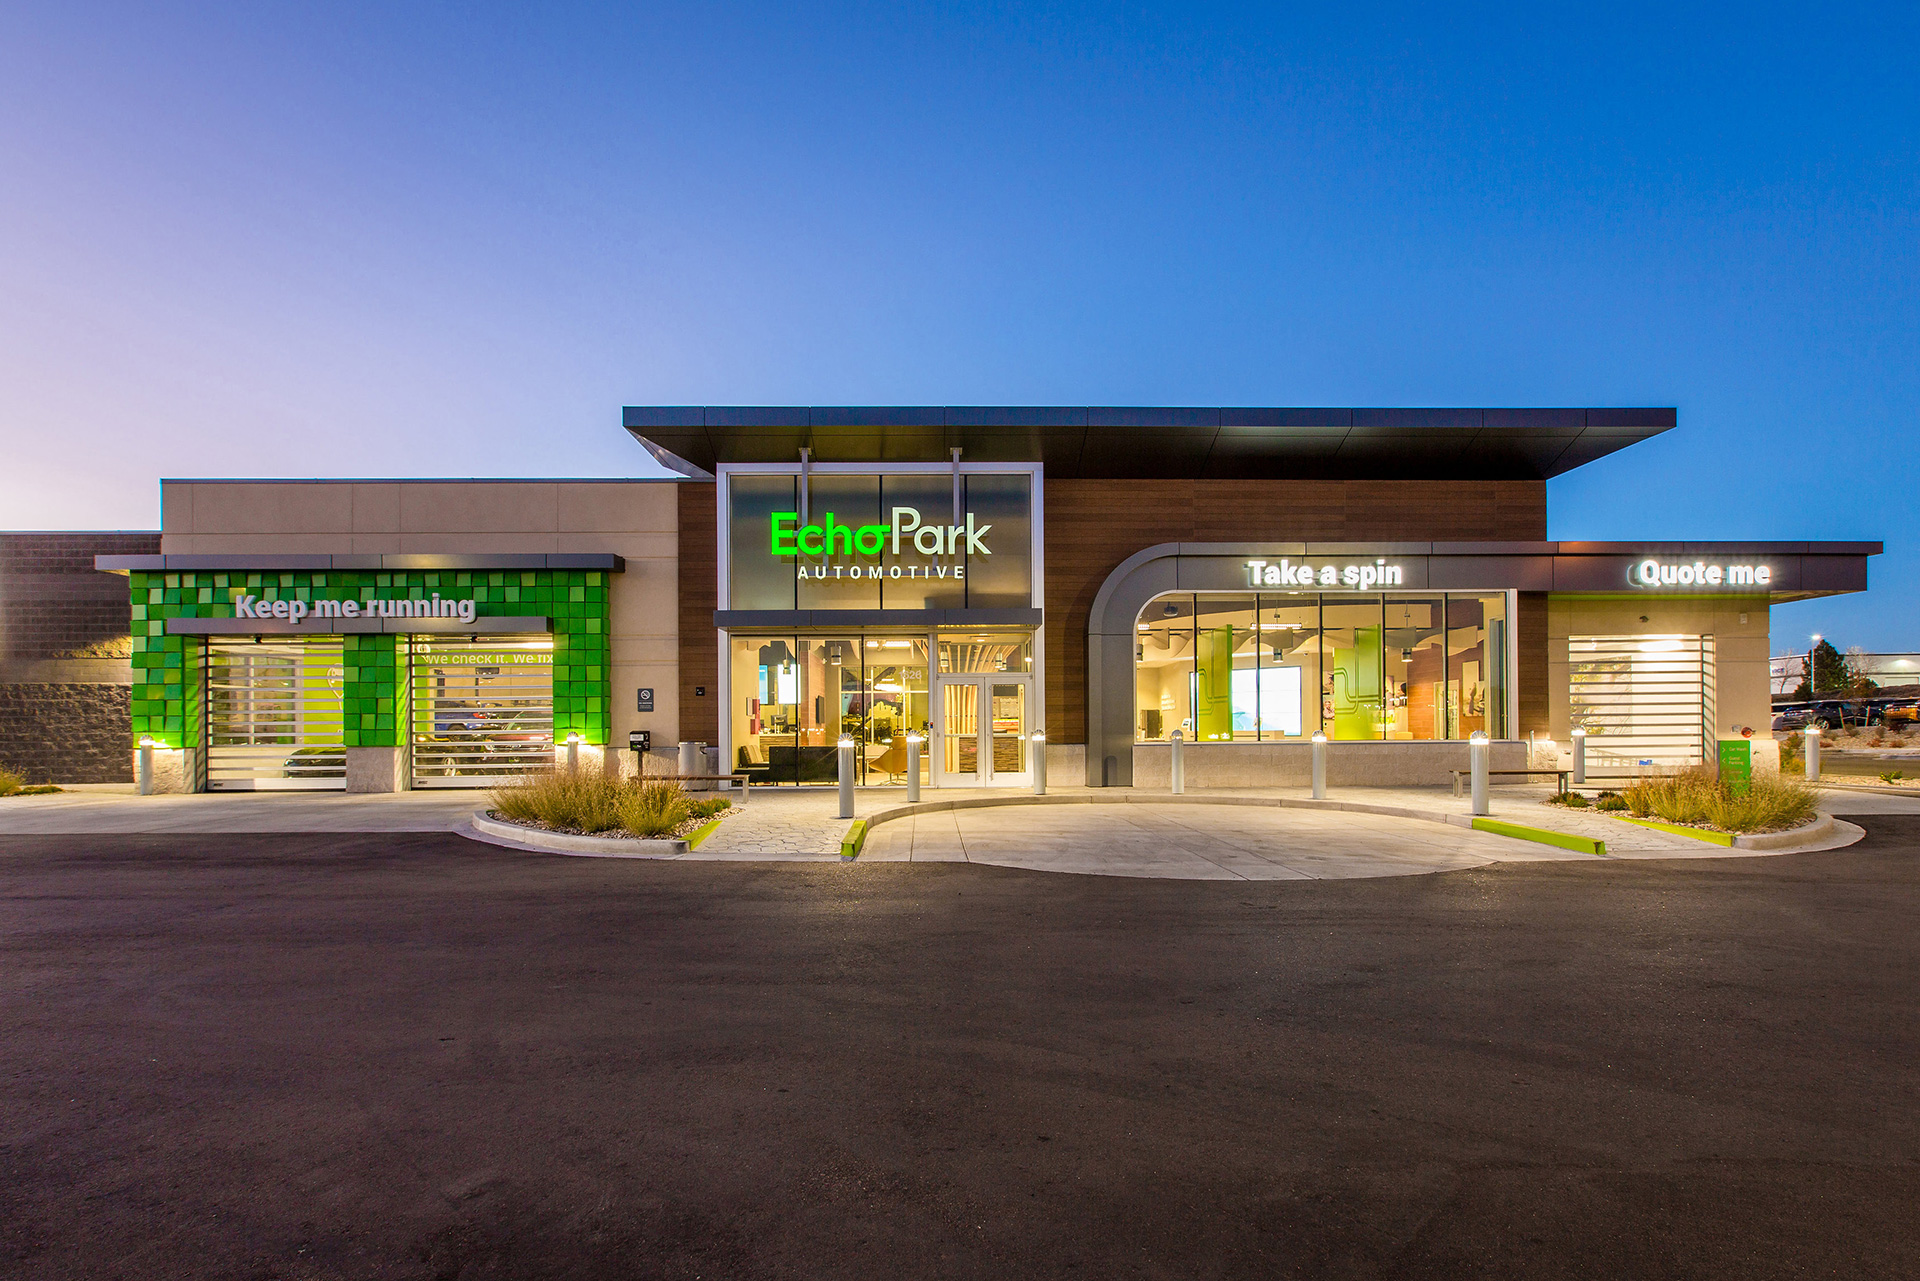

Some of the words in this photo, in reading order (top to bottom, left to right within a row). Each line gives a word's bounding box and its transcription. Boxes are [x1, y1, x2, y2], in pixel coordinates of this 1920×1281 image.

[771, 507, 992, 555] EchoPark
[797, 566, 965, 579] AUTOMOTIVE
[1248, 560, 1313, 585] Take
[1320, 566, 1336, 585] a
[1343, 560, 1403, 590] spin
[1640, 560, 1721, 586] Quote
[1727, 566, 1772, 585] me
[235, 595, 307, 624] Keep
[314, 600, 360, 618] me
[366, 593, 476, 623] running
